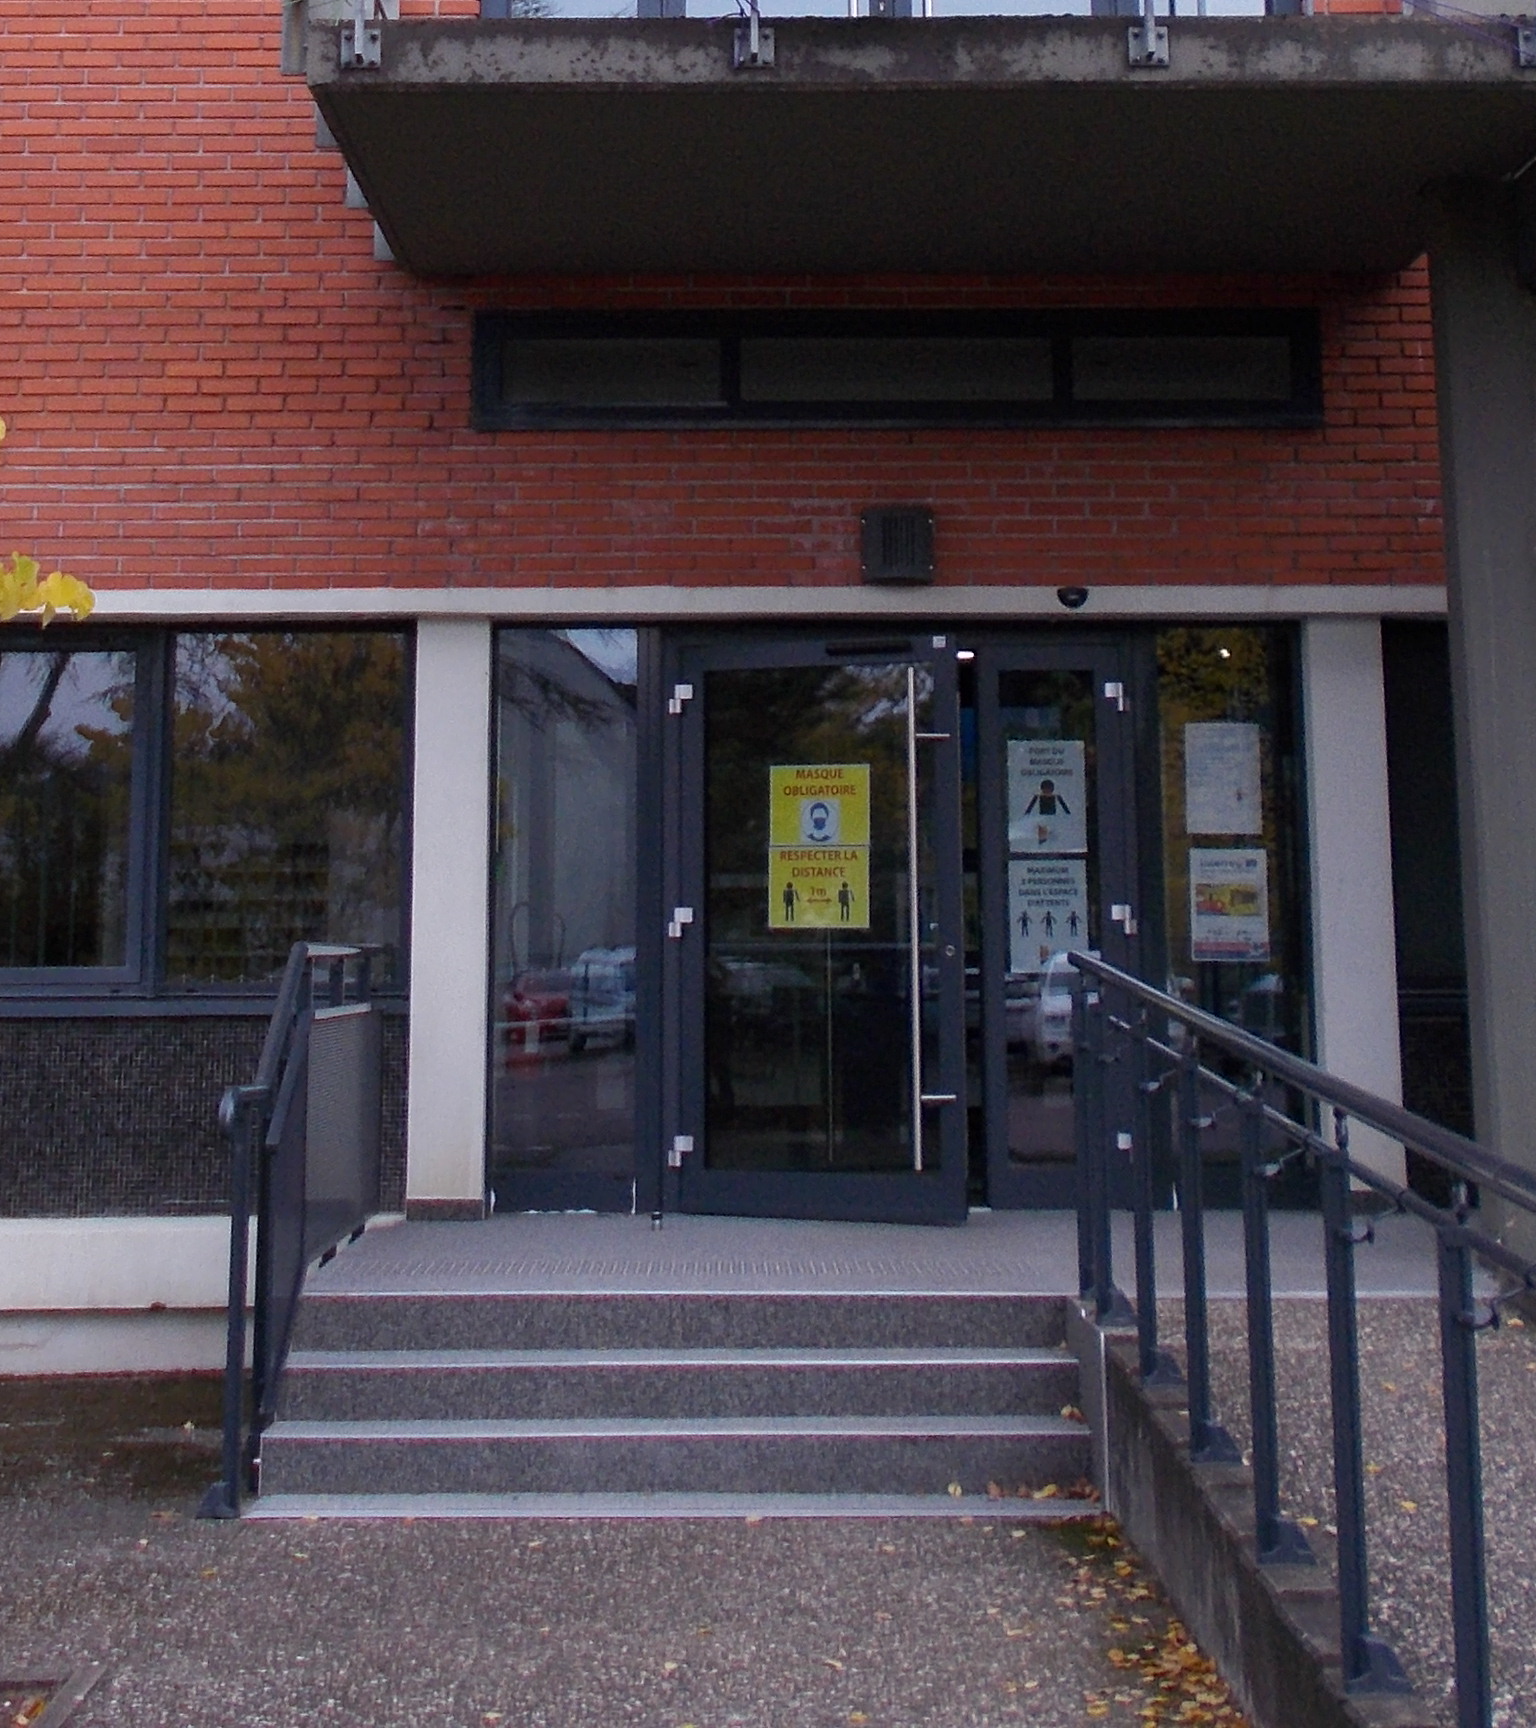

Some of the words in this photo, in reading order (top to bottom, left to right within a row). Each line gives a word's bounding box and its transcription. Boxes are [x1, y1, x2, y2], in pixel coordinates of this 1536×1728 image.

[795, 769, 844, 780] MASQUE
[783, 785, 857, 796] OBLIGATOIRE
[780, 850, 842, 861] RESPECTER
[844, 850, 858, 860] LA
[792, 866, 846, 878] DISTANCE
